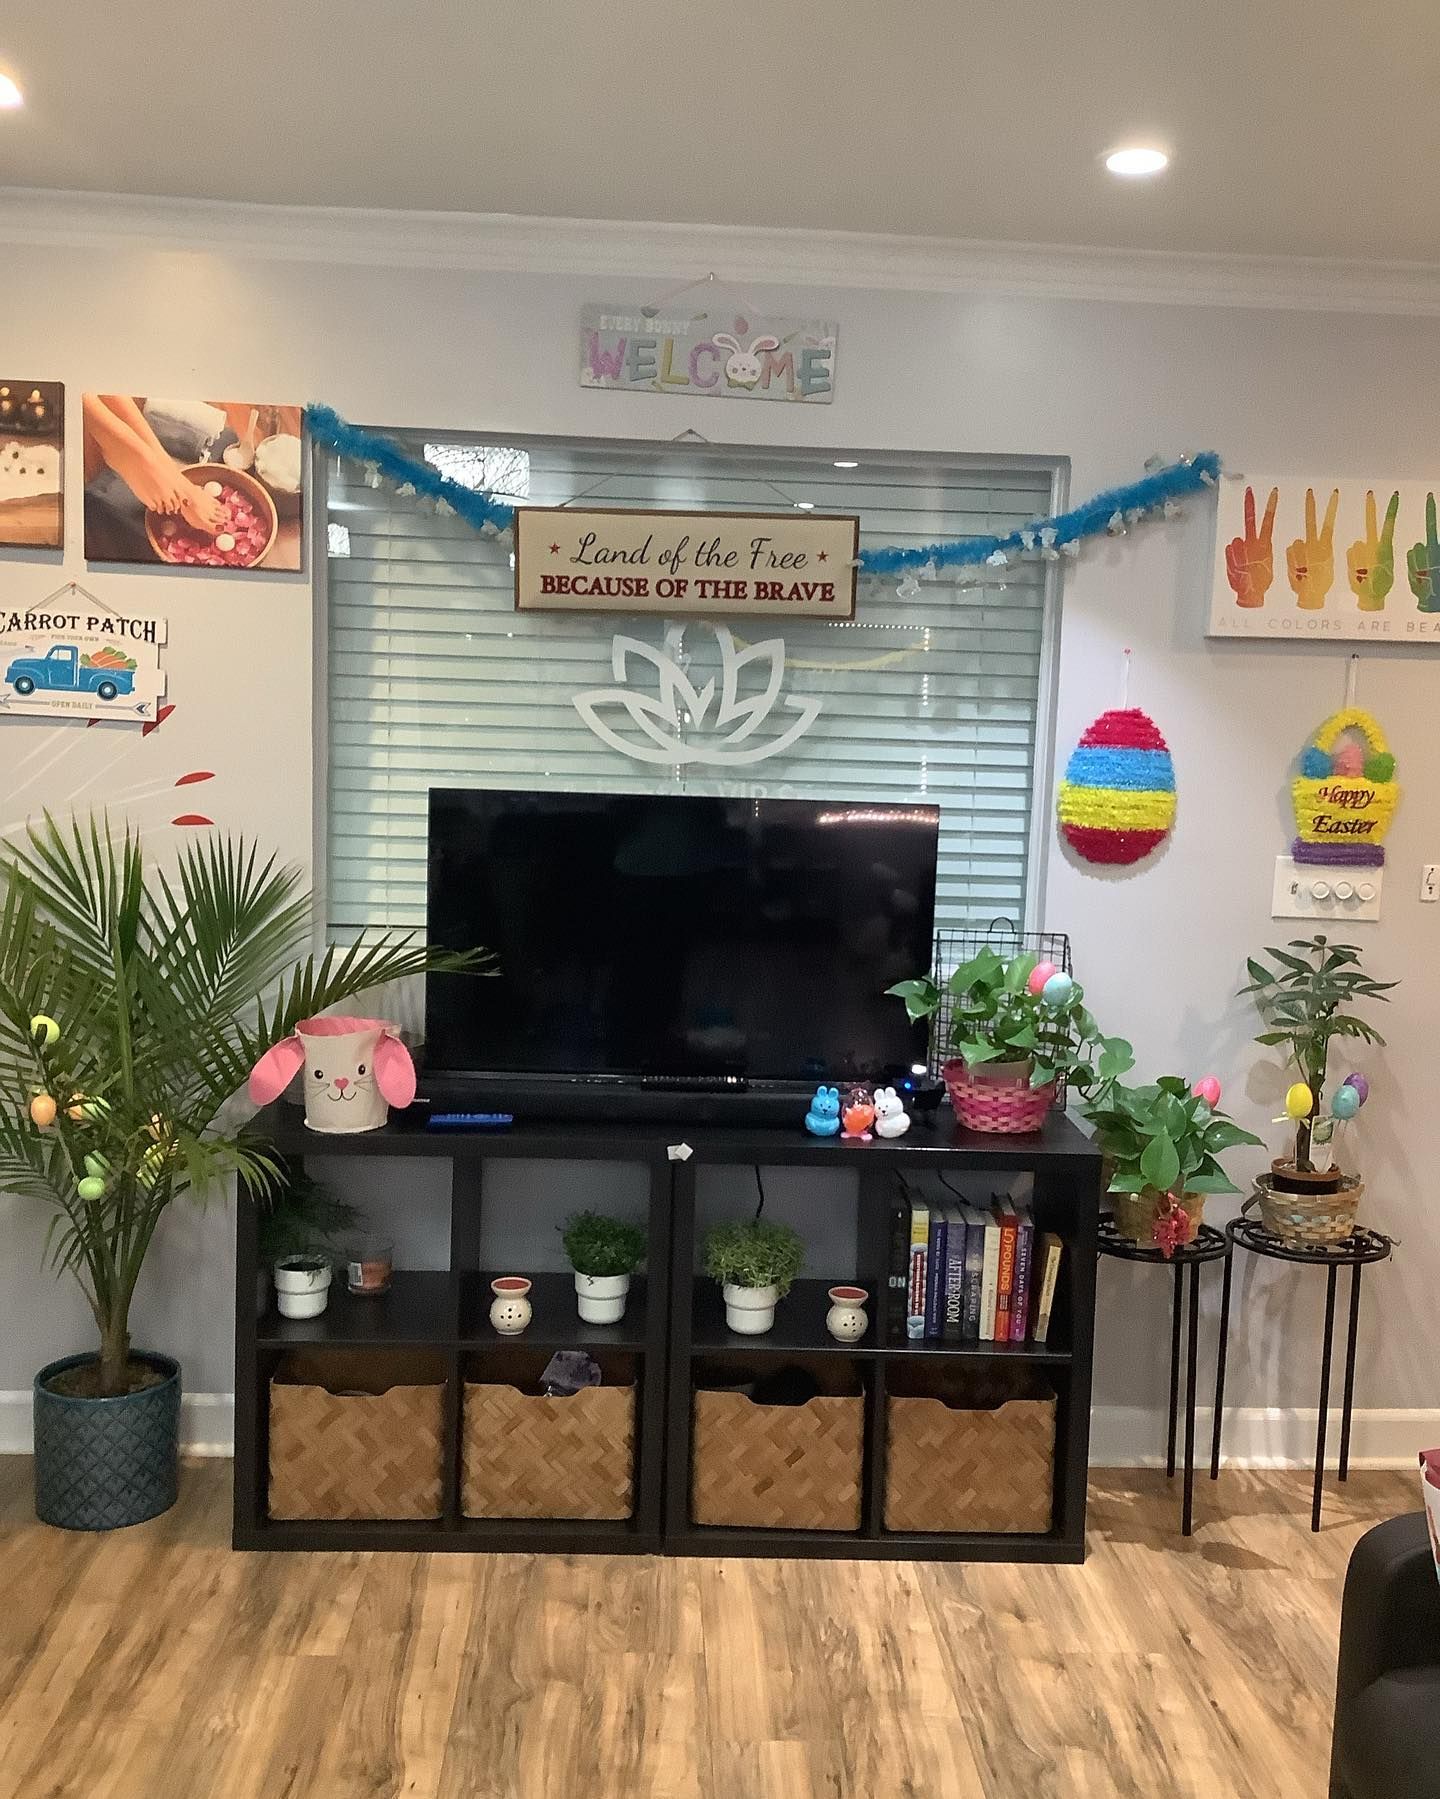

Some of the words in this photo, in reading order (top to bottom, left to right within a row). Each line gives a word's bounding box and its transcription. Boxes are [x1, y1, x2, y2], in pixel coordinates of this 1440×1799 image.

[570, 532, 653, 565] Land
[658, 535, 691, 575] of
[694, 536, 739, 568] the
[750, 537, 808, 570] Free
[540, 575, 649, 597] BECAUSE
[655, 579, 690, 599] OF
[694, 579, 748, 600] THE
[754, 581, 836, 602] BRAVE
[87, 617, 157, 643] PATCH
[1217, 616, 1250, 628] ALL
[1267, 618, 1342, 630] COLORS
[1357, 620, 1391, 633] ARE
[1318, 785, 1376, 809] Happy
[1312, 815, 1378, 834] Easter
[1001, 1244, 1012, 1291] POUNDS
[1017, 1296, 1023, 1306] OF
